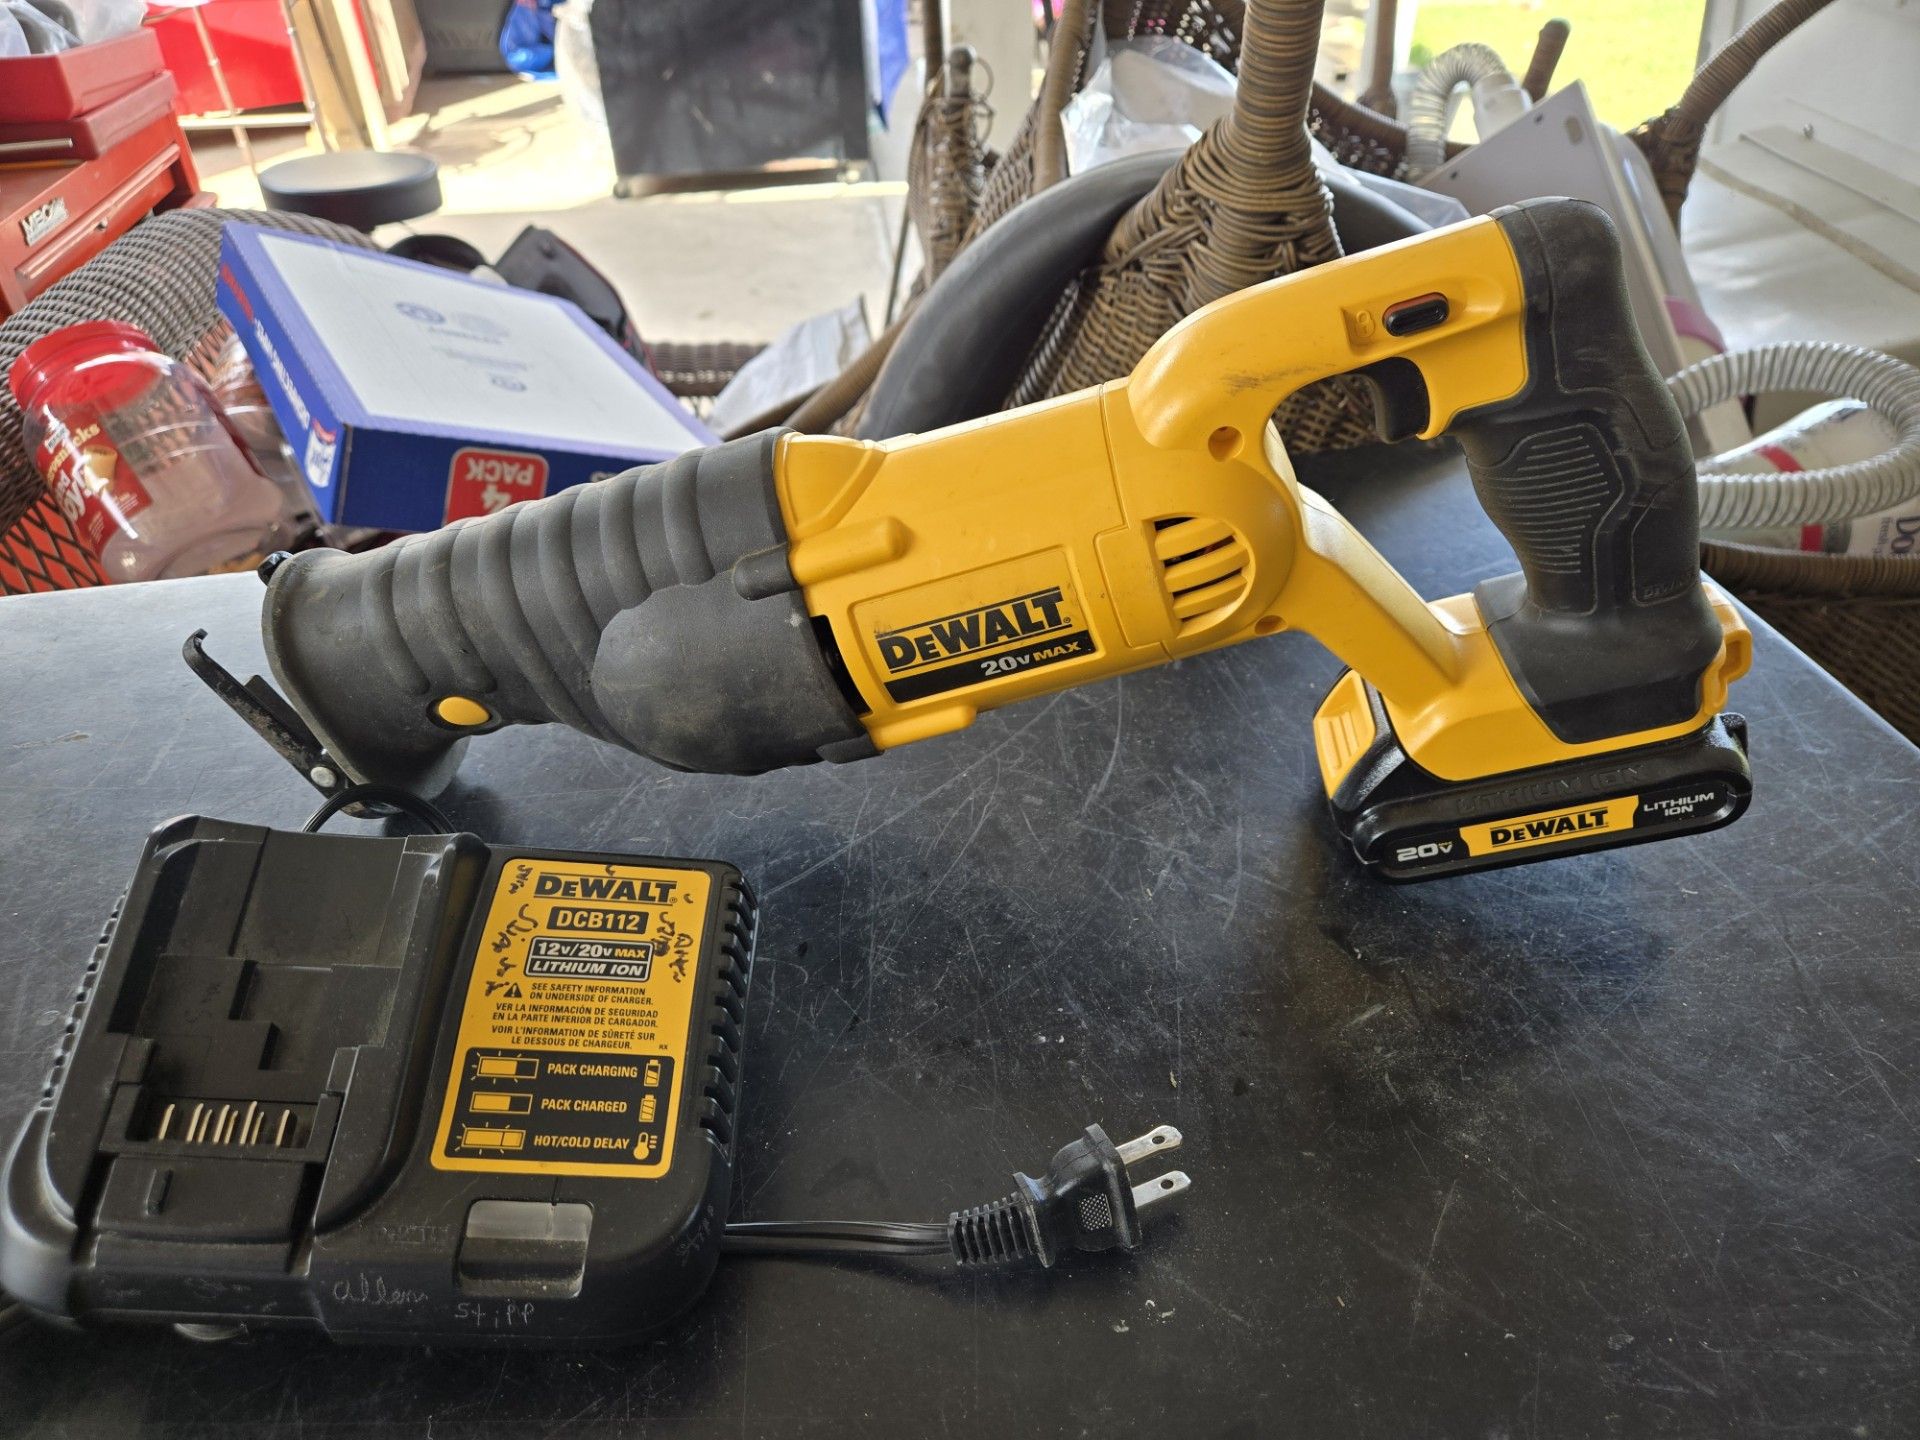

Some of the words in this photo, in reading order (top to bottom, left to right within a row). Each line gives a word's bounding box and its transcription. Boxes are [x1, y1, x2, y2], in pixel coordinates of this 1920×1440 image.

[465, 458, 534, 485] PACK
[1033, 640, 1082, 663] MAX
[1643, 792, 1715, 812] LITHIUM
[1663, 804, 1694, 817] ION
[556, 909, 641, 931] DCB112
[614, 948, 646, 959] MAX
[532, 960, 605, 975] LITHIUM
[609, 963, 644, 976] ION
[531, 983, 549, 991] SEE
[549, 983, 583, 992] SAFETY
[584, 985, 646, 996] INFORMATION
[530, 992, 544, 1000] ON
[544, 993, 596, 1003] UNDERSIDE
[597, 994, 609, 1003] OF
[610, 995, 654, 1005] CHARGER.
[496, 1003, 513, 1011] VER
[514, 1003, 527, 1012] LA
[528, 1003, 593, 1015] INFORMACIÓN
[594, 1008, 607, 1016] DE
[608, 1008, 659, 1019] SEGURIDAD
[492, 1013, 506, 1021] EN
[507, 1013, 520, 1021] LA
[521, 1014, 550, 1023] PARTE
[551, 1015, 593, 1025] INFERIOR
[594, 1017, 607, 1025] DE
[608, 1018, 659, 1028] CARGADOR.
[492, 1026, 513, 1034] VOIR
[515, 1026, 586, 1038] L'INFORMATION
[588, 1029, 600, 1038] DE
[637, 1032, 655, 1041] SUR
[511, 1036, 522, 1044] LE
[523, 1036, 566, 1046] DESSOUS
[568, 1038, 581, 1047] DE
[582, 1039, 632, 1049] CHARGEUR.
[547, 1064, 578, 1076] PACK
[579, 1065, 638, 1078] CHARGING
[541, 1099, 571, 1111] PACK
[573, 1100, 627, 1113] CHARGED
[533, 1135, 592, 1148] HOT/COLD
[593, 1136, 630, 1150] DELAY
